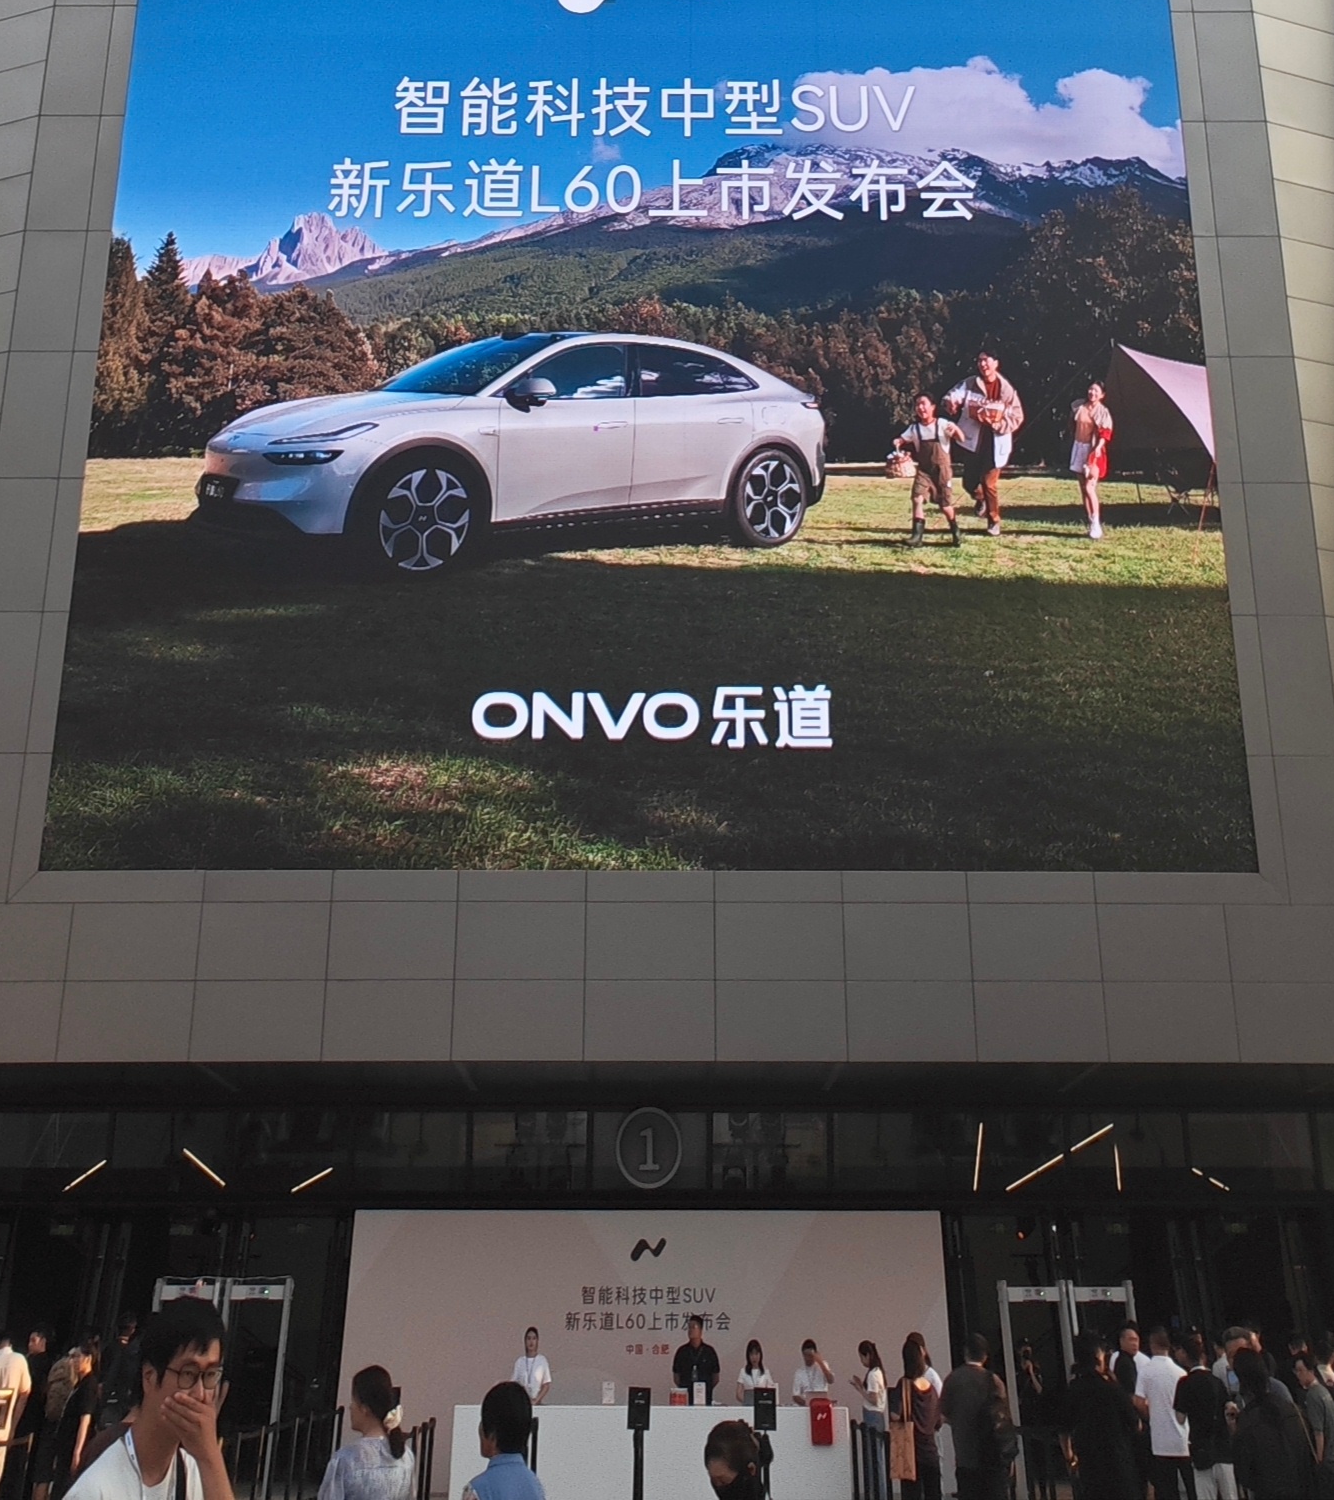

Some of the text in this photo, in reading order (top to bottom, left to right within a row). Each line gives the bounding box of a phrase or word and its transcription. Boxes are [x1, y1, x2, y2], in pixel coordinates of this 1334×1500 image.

[394, 76, 916, 138] 智能科技中型SUV
[327, 156, 979, 222] 新乐道L60上市发布会
[471, 684, 833, 748] ONVO 乐道
[638, 1127, 660, 1171] 1
[581, 1285, 717, 1305] 智能科技中型SUV
